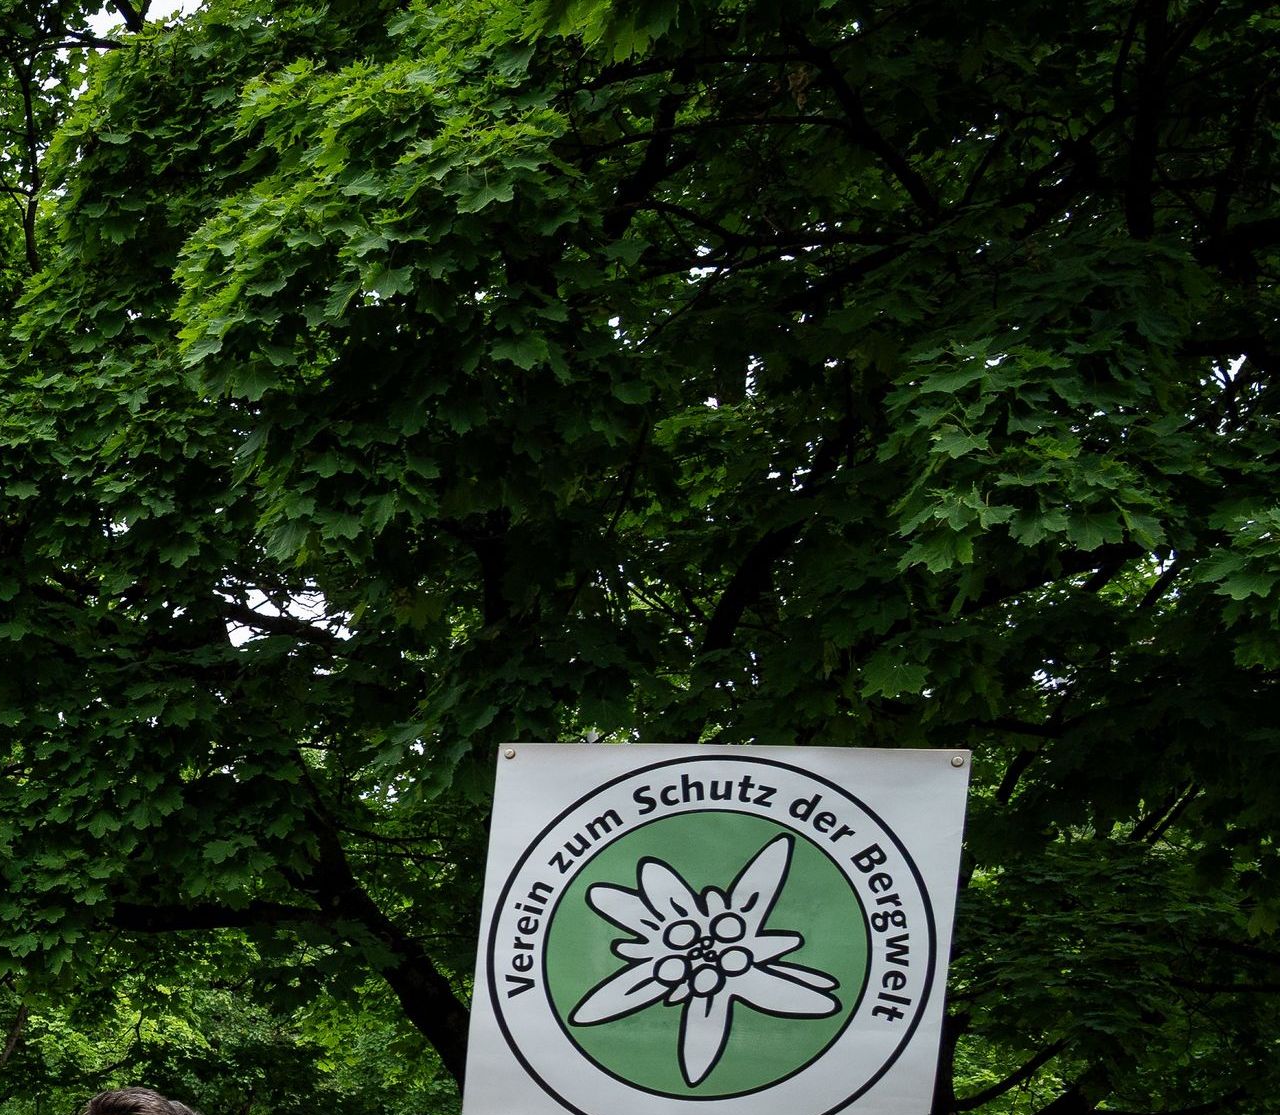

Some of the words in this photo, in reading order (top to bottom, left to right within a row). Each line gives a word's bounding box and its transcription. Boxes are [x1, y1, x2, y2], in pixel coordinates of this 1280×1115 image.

[505, 881, 553, 999] Verein
[548, 810, 623, 874] zum
[632, 773, 777, 815] Schutz
[789, 793, 856, 843] der
[851, 843, 911, 1023] Bergwelt
